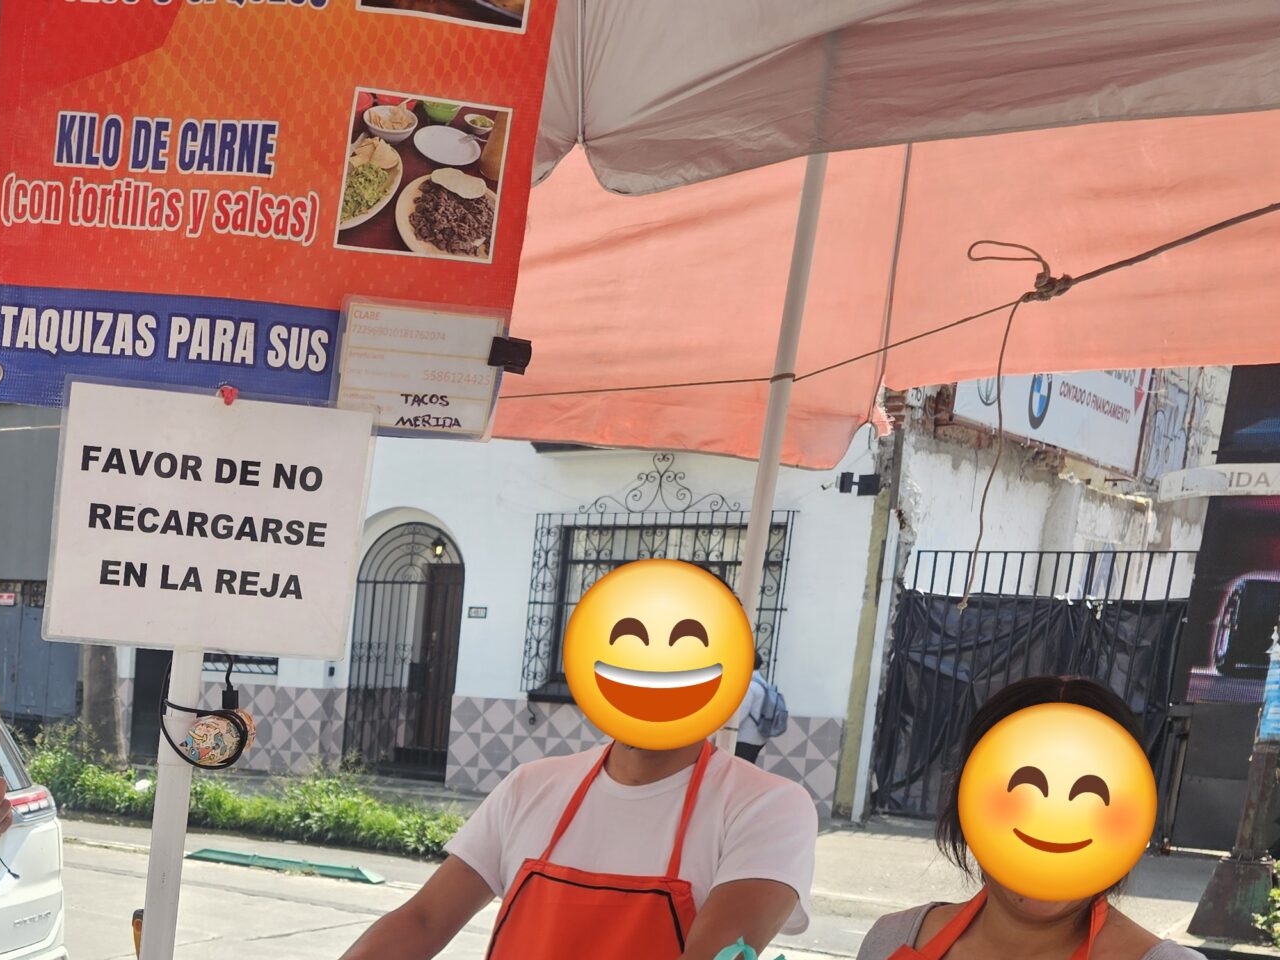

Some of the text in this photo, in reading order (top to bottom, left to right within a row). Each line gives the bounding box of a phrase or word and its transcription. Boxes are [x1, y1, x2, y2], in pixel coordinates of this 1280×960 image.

[55, 112, 278, 176] KILO DE CARNE
[1, 172, 319, 246] (con tortillas y salsas)
[354, 310, 380, 321] CLABE
[1, 306, 329, 373] TAQUIZAS PARA SUS
[400, 393, 450, 407] TACOS
[1059, 381, 1086, 405] CONTADO
[395, 414, 462, 428] MERIDA
[81, 445, 323, 492] FAVOR DE NO
[88, 502, 327, 548] RECARGARSE
[99, 560, 303, 600] EN LA REJA
